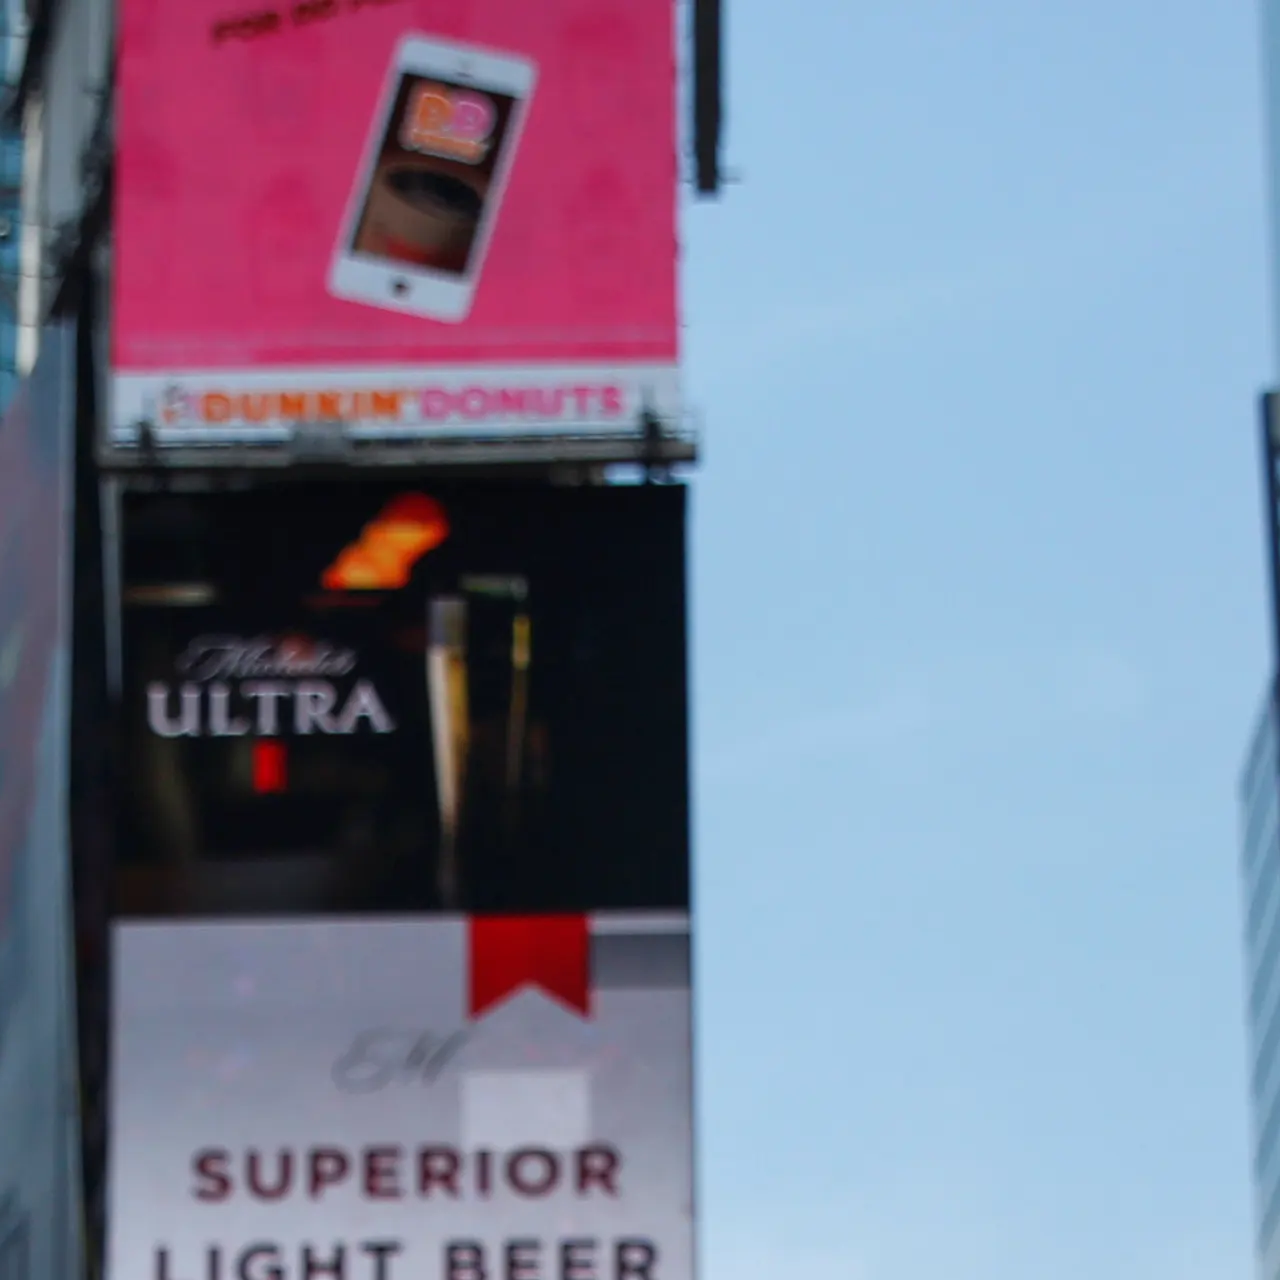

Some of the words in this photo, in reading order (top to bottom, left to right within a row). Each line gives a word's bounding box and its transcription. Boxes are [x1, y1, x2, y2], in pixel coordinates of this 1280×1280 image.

[421, 385, 625, 421] DONUTS
[146, 679, 397, 737] ULTRA
[192, 1142, 622, 1203] SUPERIOR
